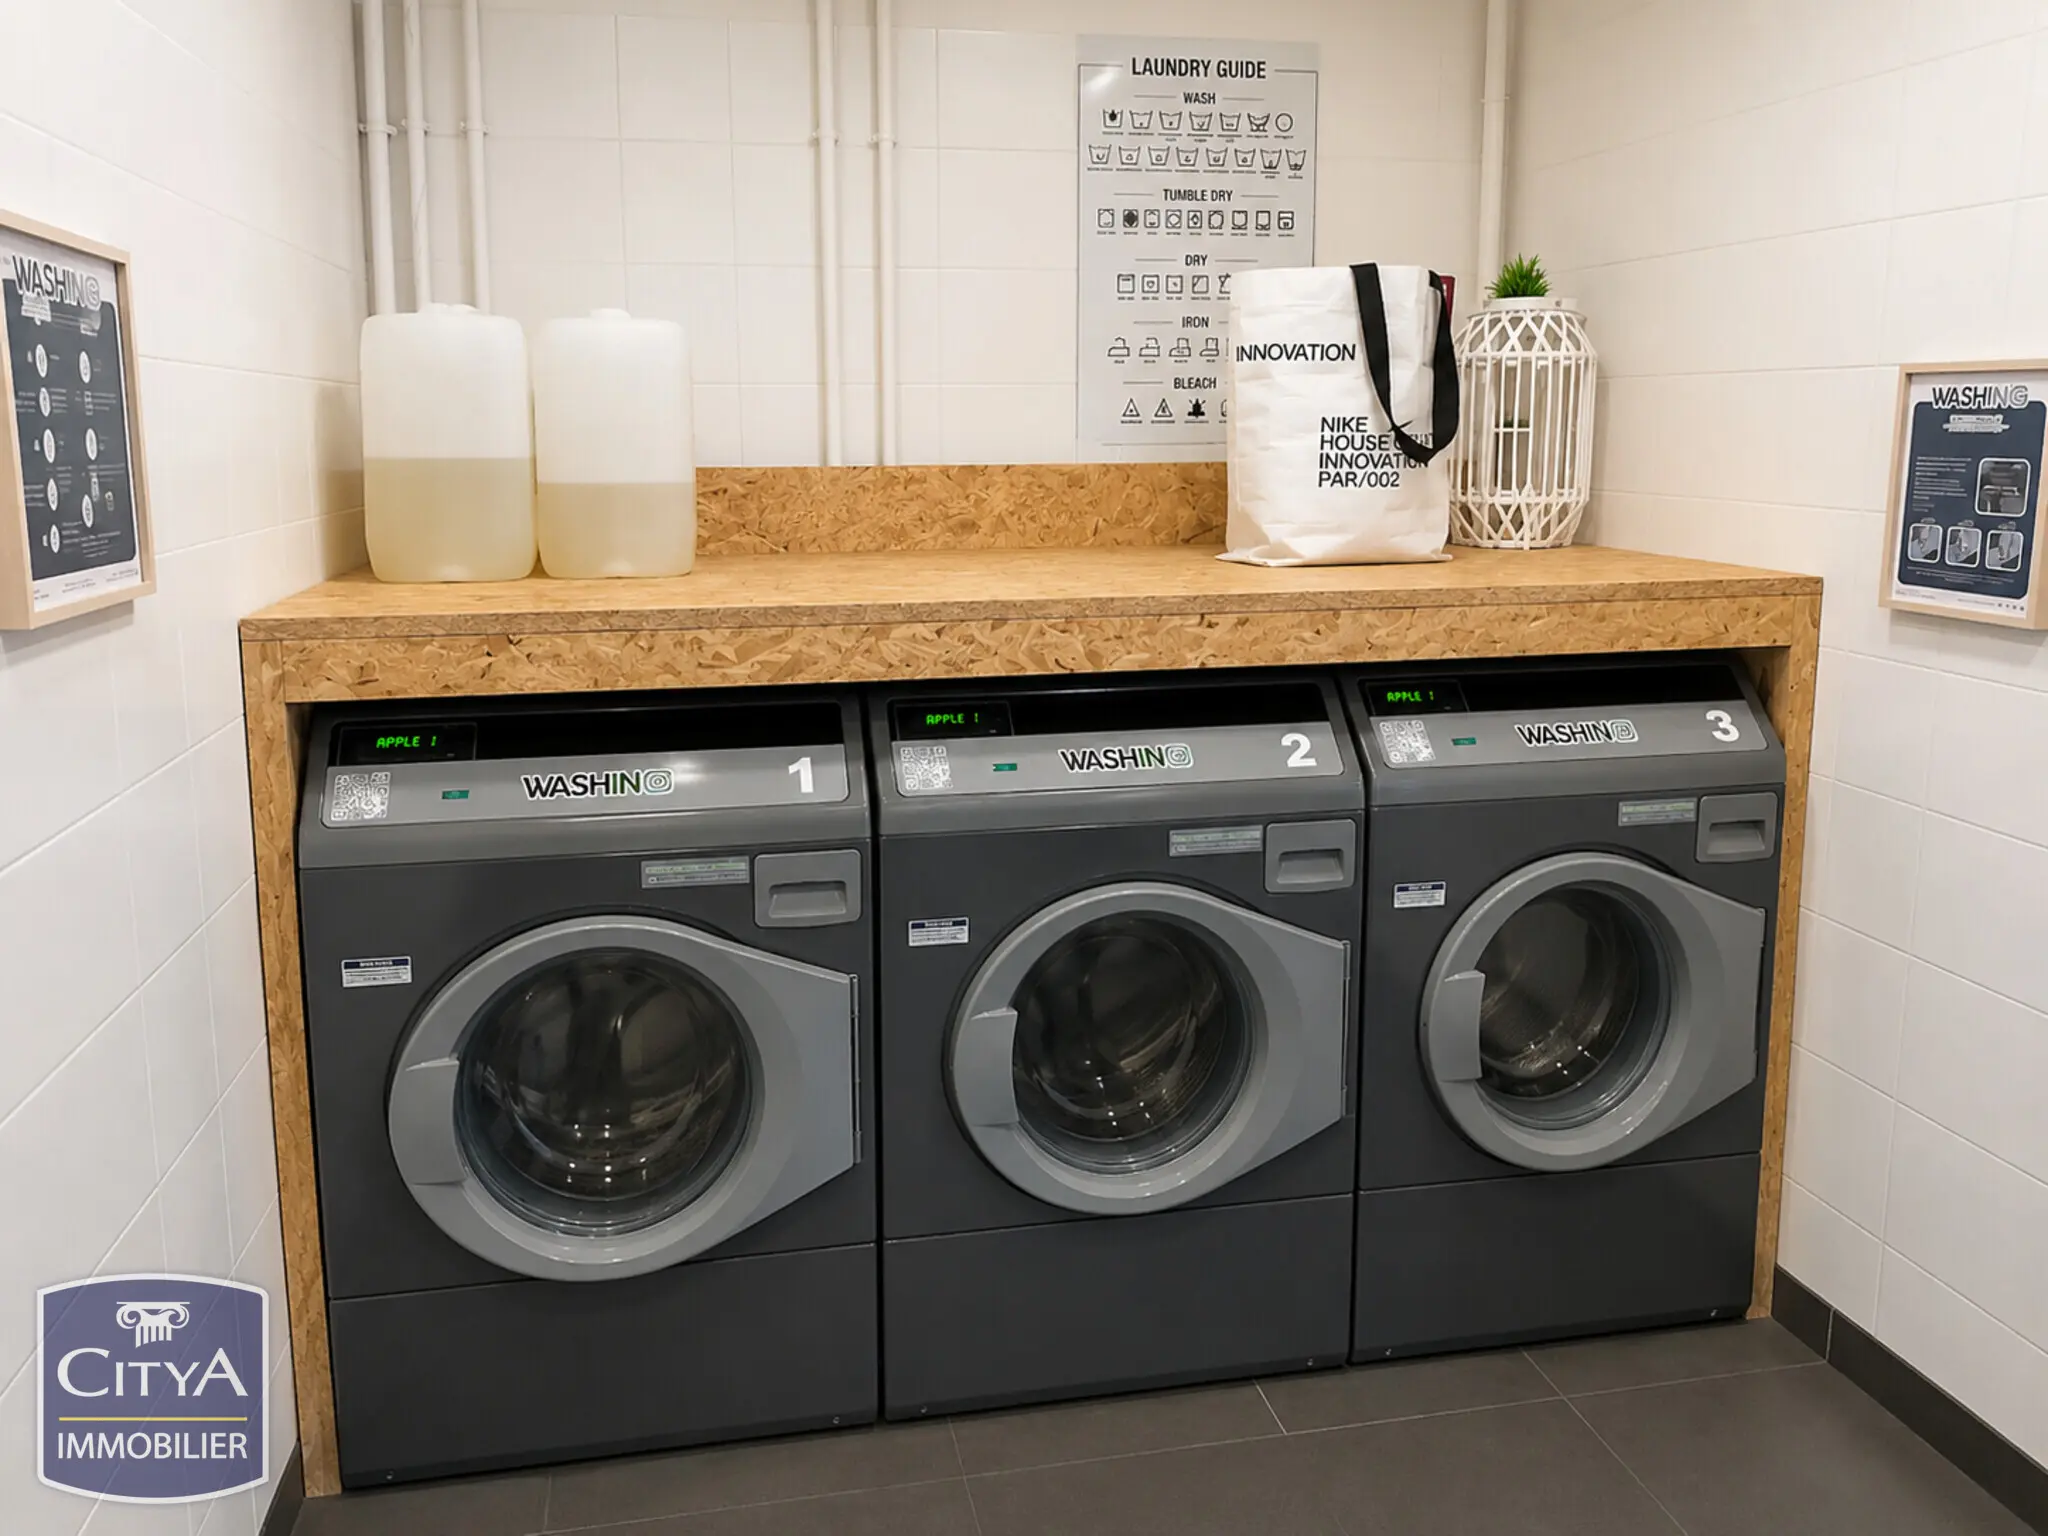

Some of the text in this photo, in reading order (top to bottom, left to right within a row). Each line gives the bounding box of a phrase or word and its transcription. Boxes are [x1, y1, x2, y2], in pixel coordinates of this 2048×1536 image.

[1131, 57, 1267, 79] LAUNDRY GUIDE
[1183, 92, 1216, 104] WASH
[1163, 189, 1233, 202] TUMBLE DRY
[1184, 254, 1208, 266] DRY
[1181, 316, 1209, 328] IRON
[1236, 343, 1356, 362] INNOVATION
[1173, 377, 1217, 389] BLEACH
[1320, 416, 1368, 433] NIKE
[1320, 434, 1390, 451] HOUSE
[1318, 471, 1400, 488] PAR/002
[926, 713, 965, 725] APPLE
[1705, 709, 1740, 742] 3
[376, 736, 420, 748] APPLE
[1281, 732, 1317, 768] 2
[788, 757, 814, 793] 1
